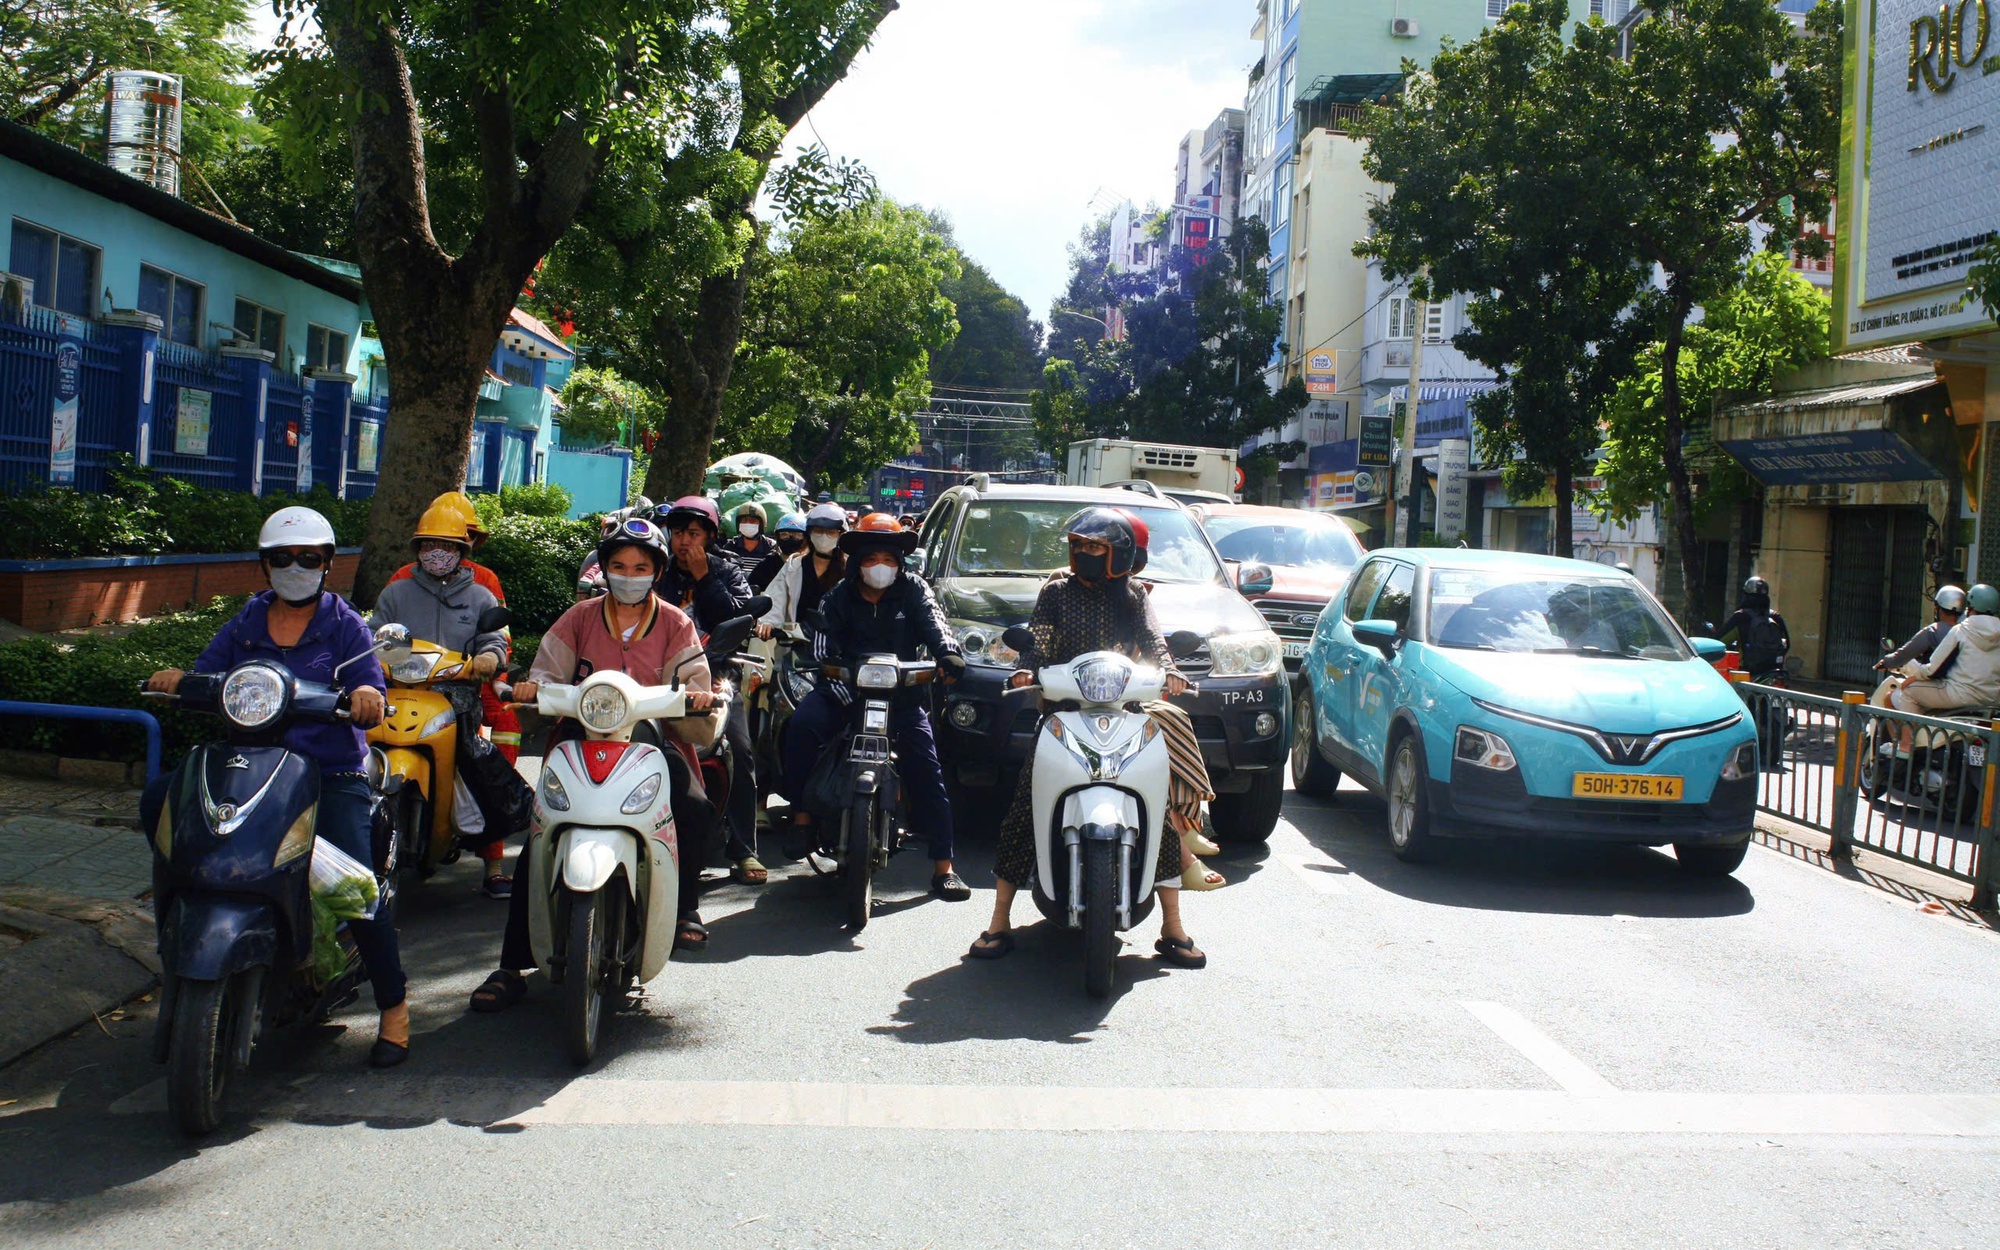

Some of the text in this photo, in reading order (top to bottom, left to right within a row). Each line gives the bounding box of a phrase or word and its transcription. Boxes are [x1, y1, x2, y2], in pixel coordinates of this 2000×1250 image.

[1907, 0, 1990, 93] RIO
[1190, 220, 1205, 233] DU
[1867, 315, 1881, 331] CHÍNH
[1909, 307, 1924, 324] QUẬN
[1312, 383, 1329, 391] 24H
[1443, 461, 1466, 470] TRƯỜNG
[1771, 453, 1814, 470] HÀNG
[1807, 447, 1861, 468] THUỐC
[1443, 511, 1461, 519] THÔNG
[1301, 616, 1317, 624] Ford
[1222, 690, 1264, 705] TP-A3
[1583, 777, 1673, 796] 50H-376.14
